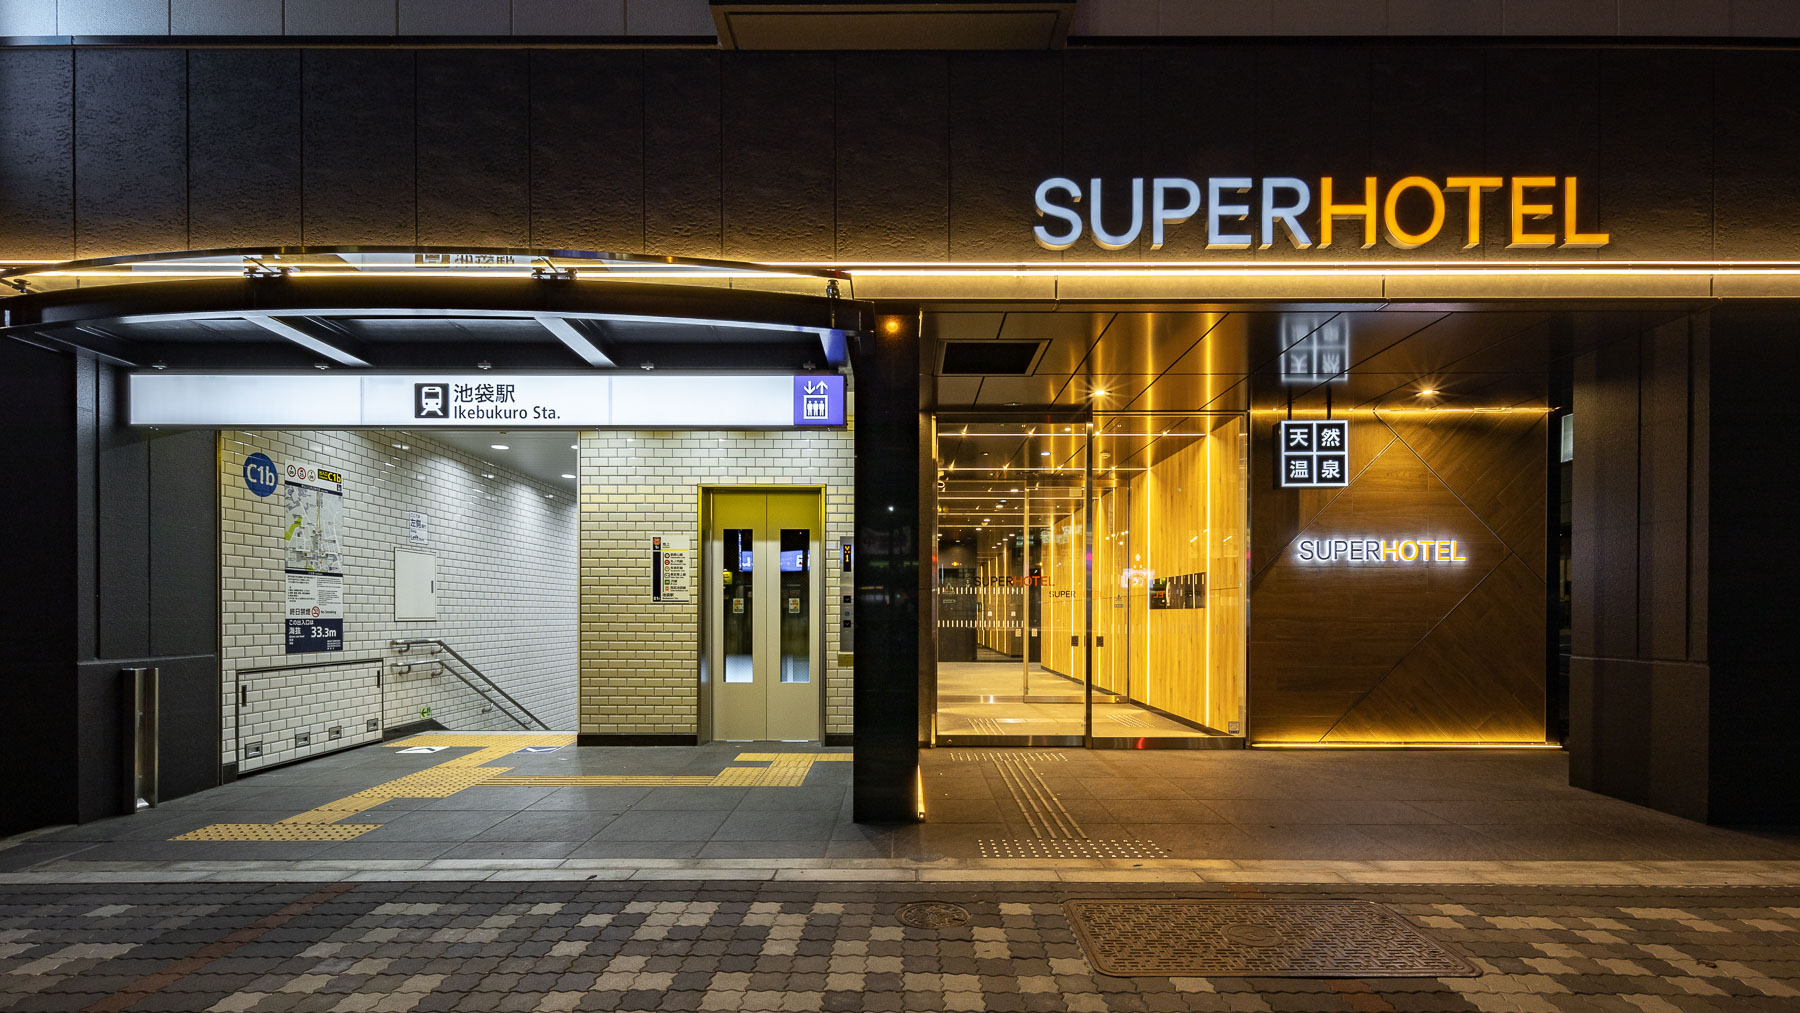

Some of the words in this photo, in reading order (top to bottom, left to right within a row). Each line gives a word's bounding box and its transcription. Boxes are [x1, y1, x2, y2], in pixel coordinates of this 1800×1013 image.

[1033, 176, 1610, 250] SUPERHOTEL
[453, 383, 516, 404] 池袋駅
[453, 405, 528, 420] Ikebukuro
[533, 406, 561, 420] Sta.
[1289, 428, 1341, 448] 天然
[246, 462, 276, 487] C1b
[327, 472, 342, 483] C1b
[1289, 460, 1341, 479] 温泉
[1298, 540, 1467, 562] SUPERHOTEL
[974, 575, 1055, 587] SUPERHOTEL
[310, 626, 337, 638] 33.3m
